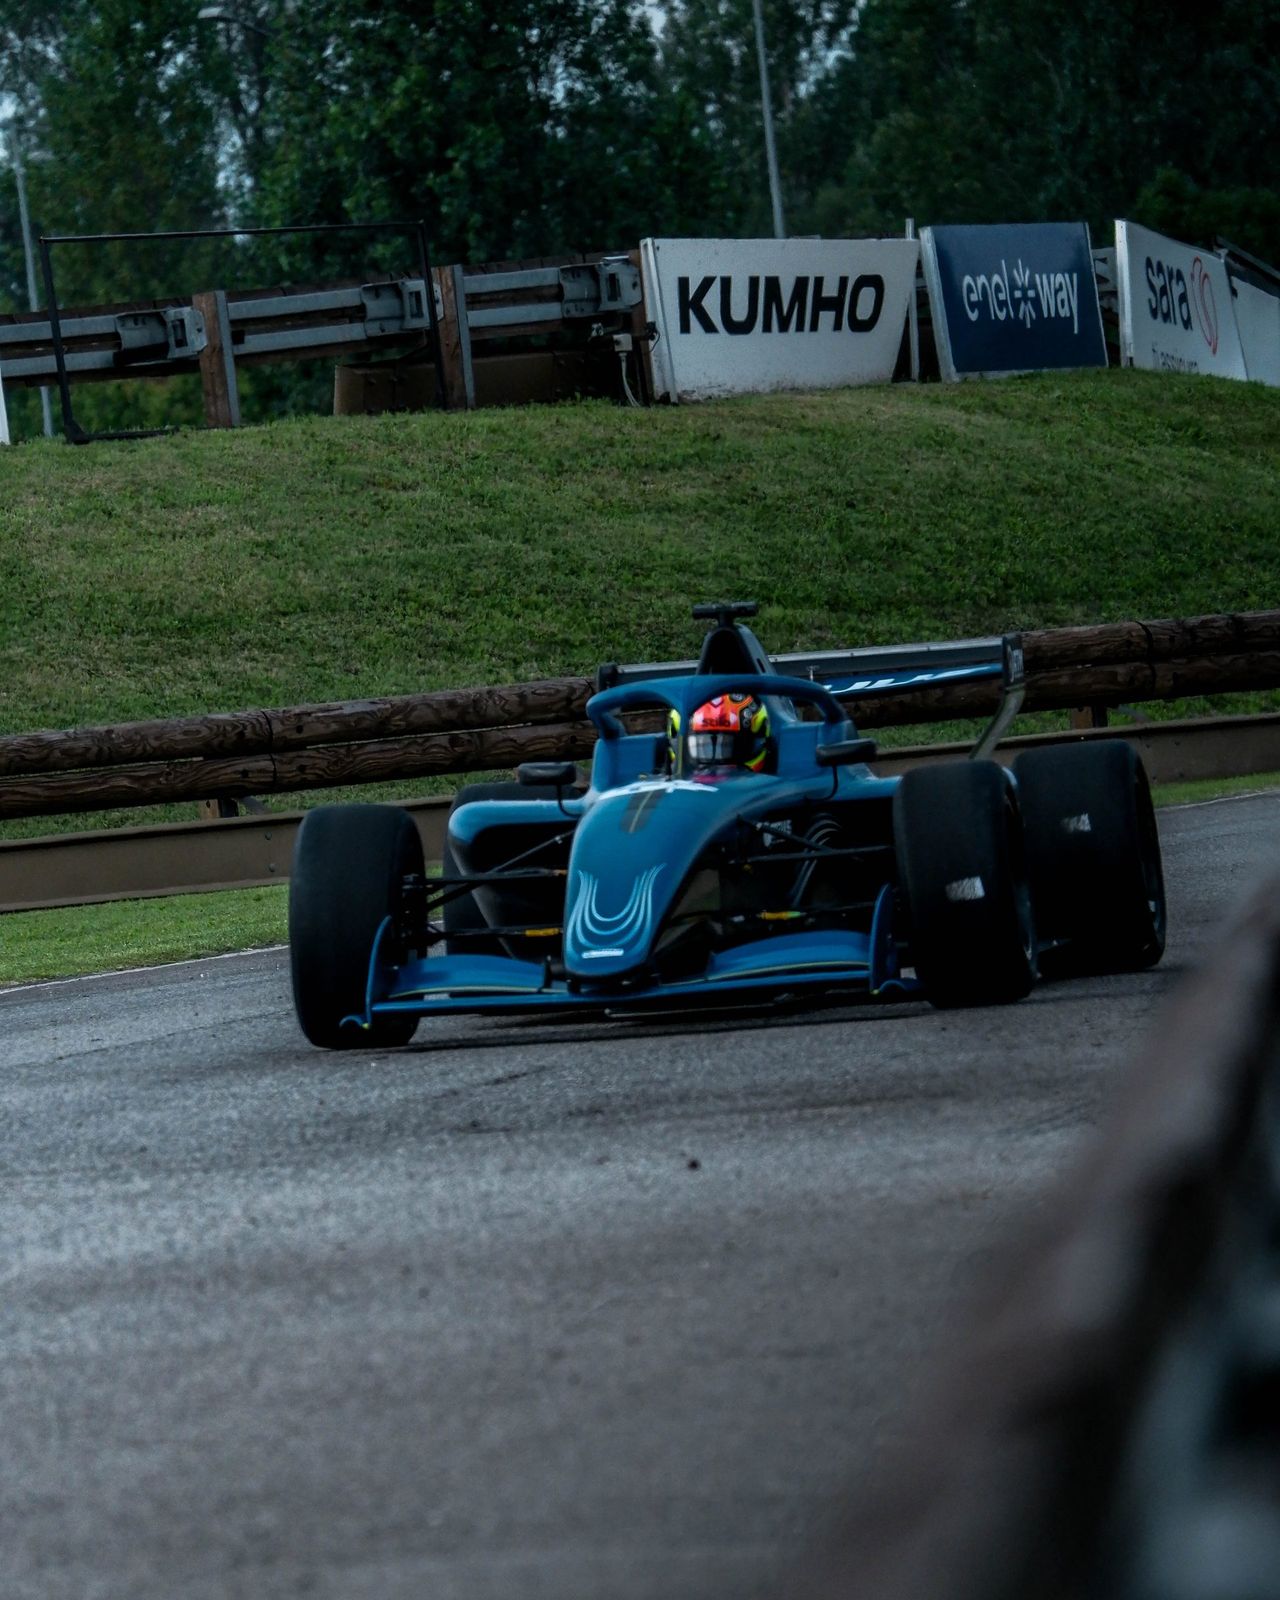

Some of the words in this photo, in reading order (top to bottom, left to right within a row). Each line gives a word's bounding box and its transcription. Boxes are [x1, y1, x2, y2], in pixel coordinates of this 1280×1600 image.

[678, 274, 884, 335] KUMHO
[962, 258, 1015, 322] enel
[1035, 272, 1079, 335] way
[1145, 256, 1193, 331] sara
